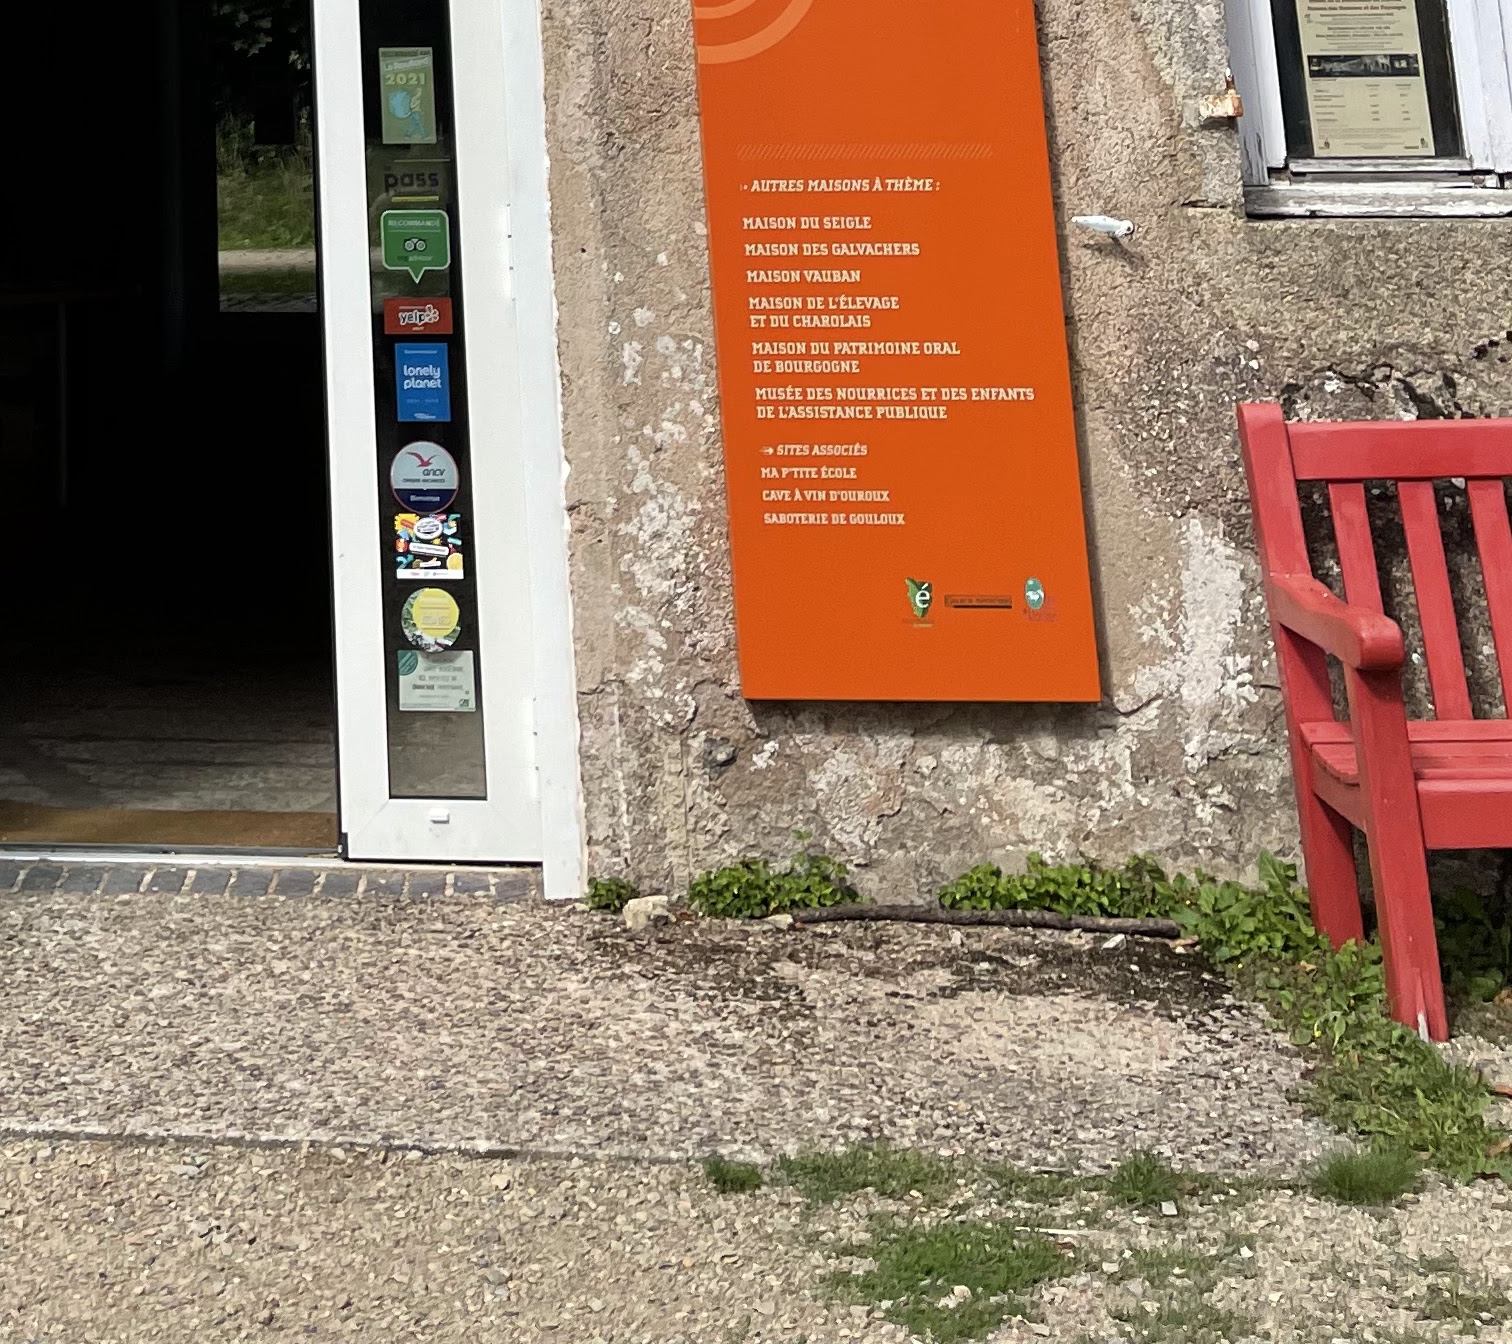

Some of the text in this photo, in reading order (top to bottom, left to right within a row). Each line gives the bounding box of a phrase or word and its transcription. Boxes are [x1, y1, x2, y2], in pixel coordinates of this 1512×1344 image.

[385, 73, 426, 85] 2021
[384, 172, 439, 193] pass
[750, 179, 804, 192] AUTRES
[807, 179, 870, 192] MAISONS
[872, 176, 883, 192] À
[885, 176, 933, 191] THÈME
[742, 216, 871, 230] MAISON DU SEIGLE
[744, 243, 920, 256] MAISON DES GALVACHERS
[746, 270, 861, 283] MAISON VAUBAN
[749, 297, 802, 310] MAISON
[807, 297, 825, 309] DE
[400, 311, 425, 325] yelp
[750, 315, 871, 328] ET DU CHAROLAIS
[752, 342, 960, 355] MAISON DU PATRIMOINE ORAL
[403, 364, 441, 379] lonely
[753, 360, 860, 373] DE BOURGOGNE
[403, 378, 442, 390] planet
[755, 385, 1035, 401] MUSÉE DES NOURRICES ET DES ENFANTS
[757, 406, 775, 419] DE
[876, 406, 948, 420] PUBLIQUE
[776, 442, 868, 456] SITES ASSOCIÉS
[761, 467, 779, 479] MA
[821, 465, 857, 479] ÉCOLE
[762, 490, 791, 502] CAVE
[794, 487, 803, 502] À
[803, 490, 826, 502] VIN
[764, 513, 905, 525] SABOTERIE DE GOULOUX
